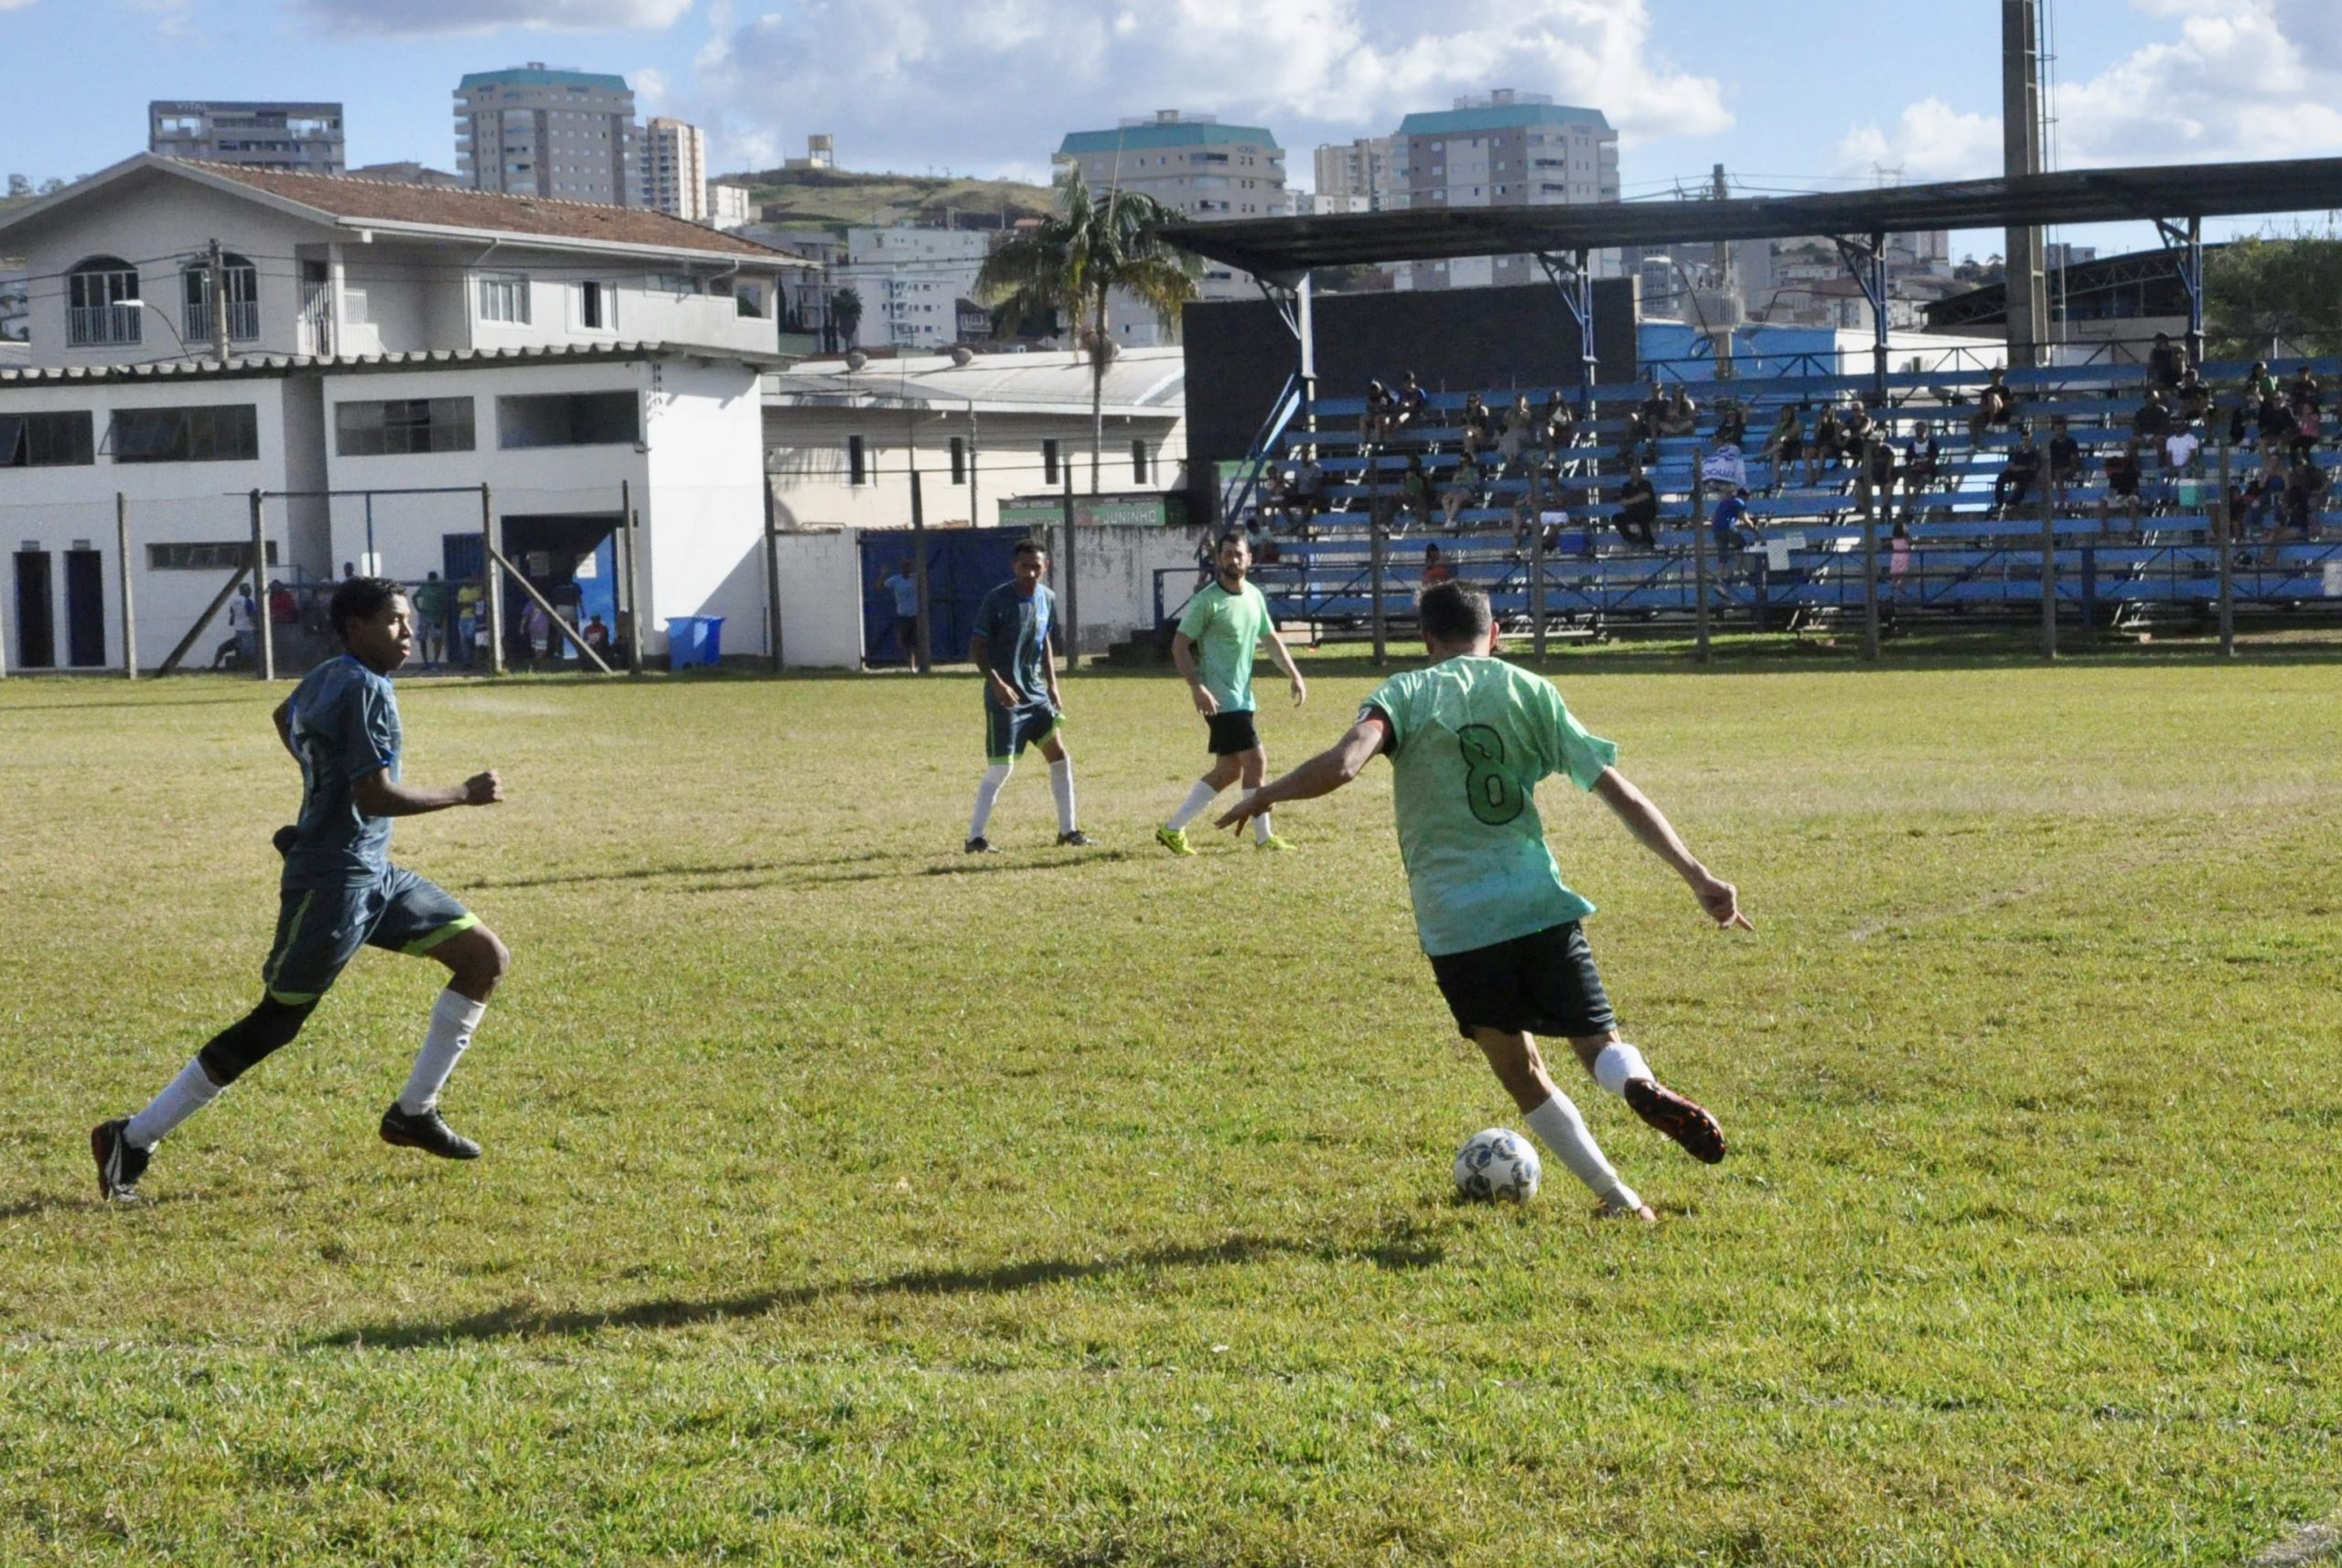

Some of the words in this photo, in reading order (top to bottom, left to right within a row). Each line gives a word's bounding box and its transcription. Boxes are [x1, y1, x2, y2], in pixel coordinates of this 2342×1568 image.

[176, 102, 209, 111] VITAL
[1103, 510, 1157, 524] JUNINHO
[1457, 724, 1524, 826] 8
